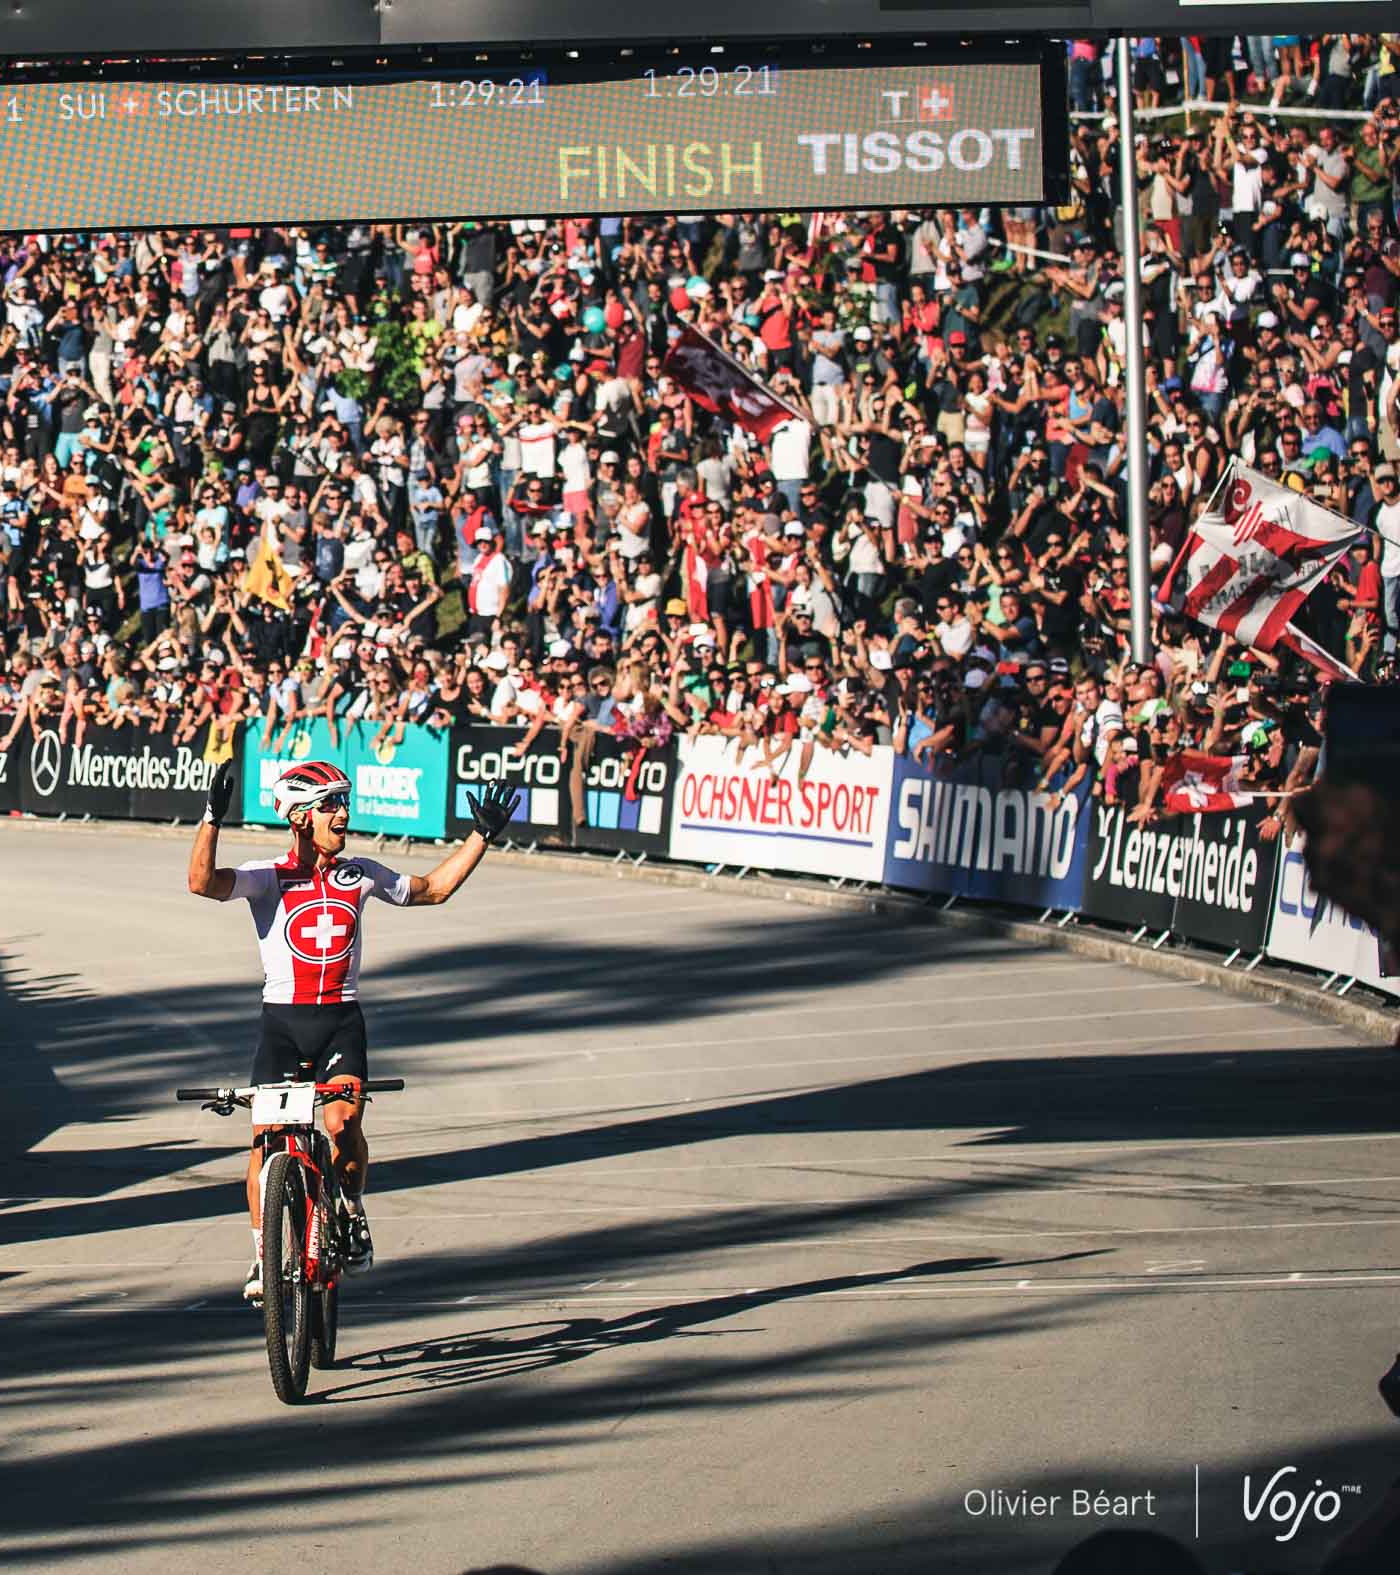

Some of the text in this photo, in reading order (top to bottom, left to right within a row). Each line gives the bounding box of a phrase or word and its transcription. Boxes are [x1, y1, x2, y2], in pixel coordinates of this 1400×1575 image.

[6, 64, 778, 123] 1 SUI SCHURTER N 1:29:21 1:29:21
[559, 142, 763, 199] FINISH
[798, 128, 1035, 175] TISSOT
[67, 743, 218, 792] Mercedes-Ben
[457, 744, 561, 785] GoPro
[682, 772, 879, 834] OCHSNER SPORT
[894, 778, 1079, 880] SHIMANO
[1109, 809, 1258, 912] Lenzerheide
[280, 1092, 289, 1110] 1
